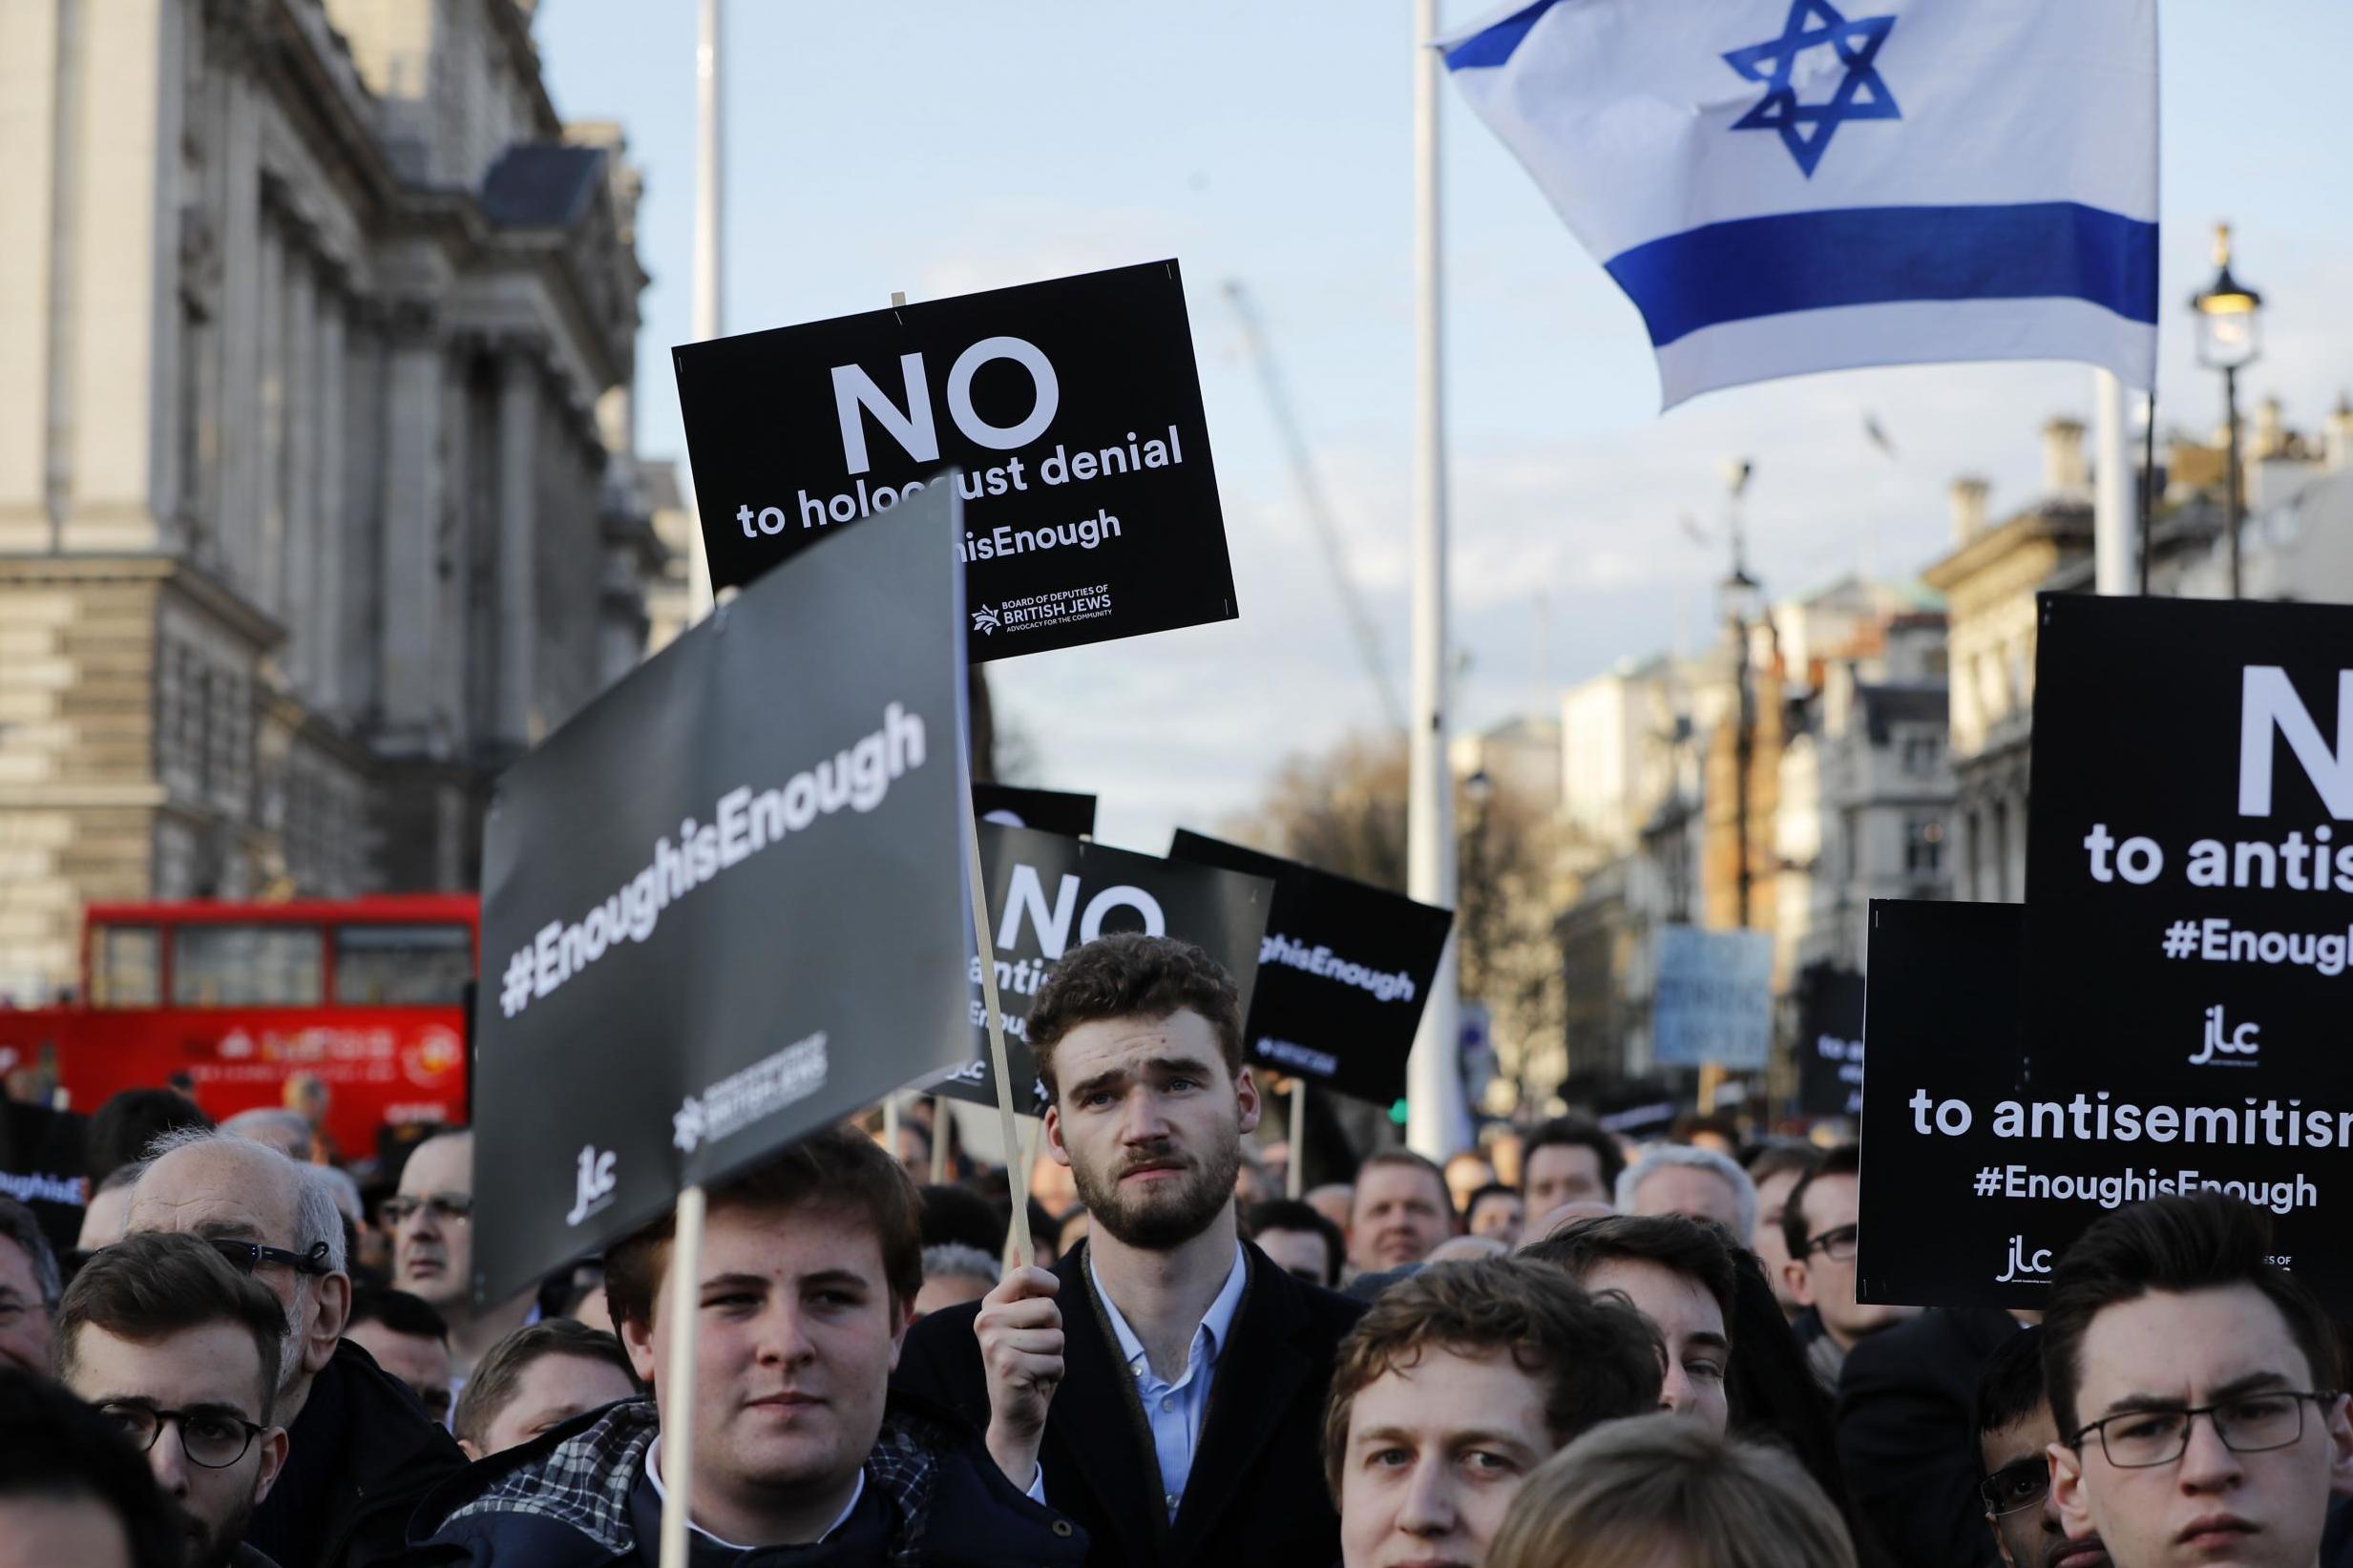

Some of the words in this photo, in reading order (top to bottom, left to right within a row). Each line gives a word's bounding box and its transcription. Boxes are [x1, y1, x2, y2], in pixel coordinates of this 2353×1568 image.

[830, 336, 1060, 475] NO
[737, 504, 786, 538] to
[1040, 425, 1183, 486] denial
[1002, 596, 1035, 610] BOARD
[1036, 594, 1049, 604] OF
[1050, 586, 1095, 601] DEPUTIES
[1096, 584, 1108, 594] OF
[1004, 602, 1066, 624] BRITISH
[1069, 594, 1112, 614] JEWS
[1006, 620, 1043, 633] ADVOCACY
[1072, 609, 1113, 621] COMMUNITY
[499, 701, 926, 1018] #EnoughisEnough
[2084, 824, 2163, 884] to
[2162, 918, 2353, 975] #Enoug
[1909, 1089, 1972, 1136] to
